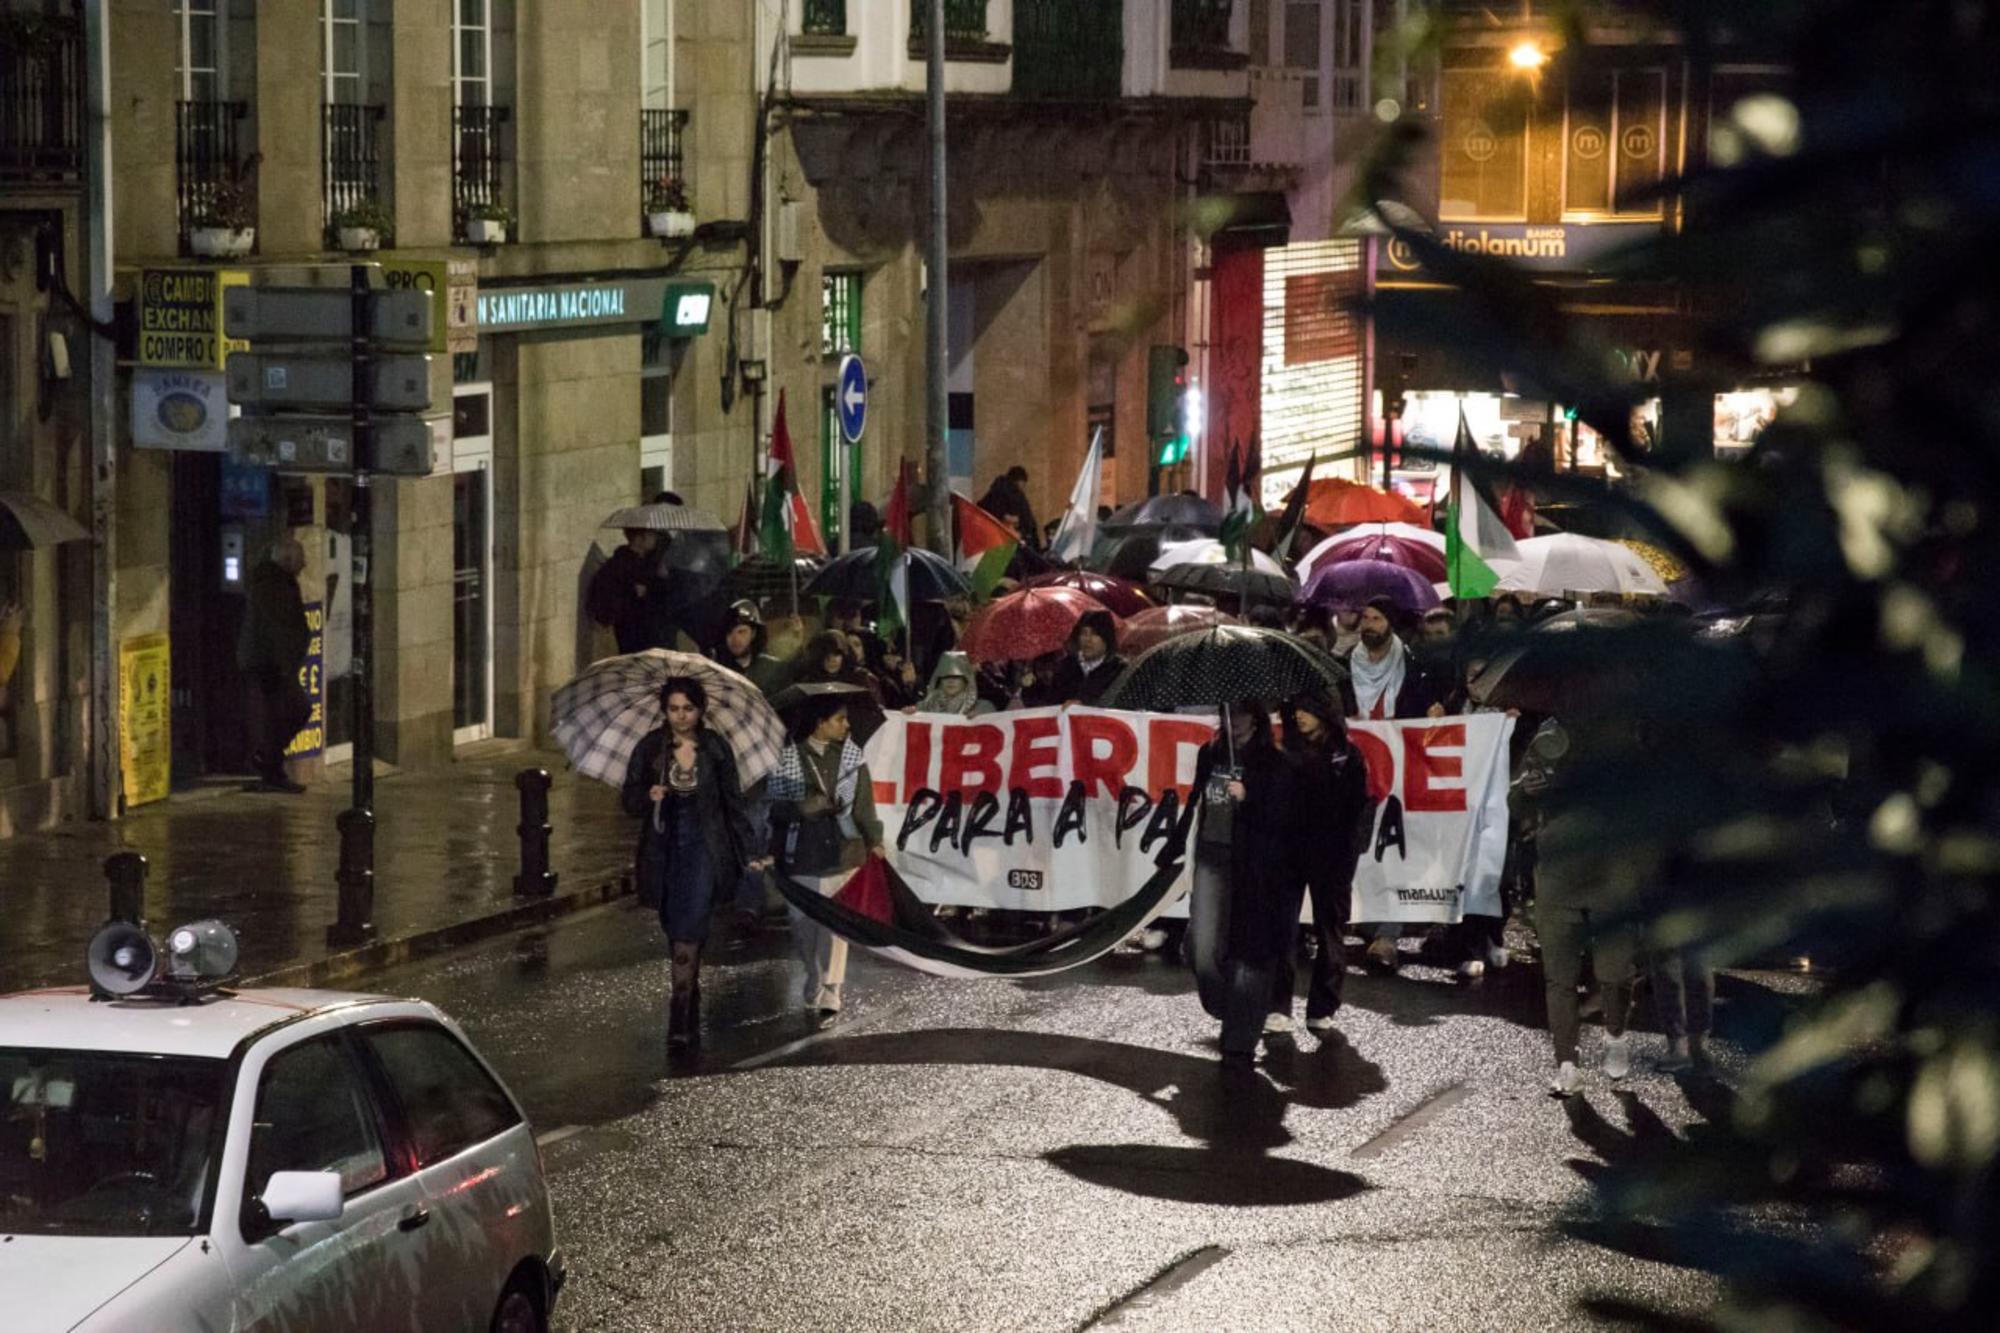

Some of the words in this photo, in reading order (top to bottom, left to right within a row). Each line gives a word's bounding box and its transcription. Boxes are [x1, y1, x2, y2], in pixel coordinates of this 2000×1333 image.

[1526, 229, 1565, 239] BANCO
[490, 291, 556, 325] SANITARIA
[560, 288, 625, 320] NACIONAL
[145, 336, 204, 362] COMPRO
[897, 787, 1033, 858] PARA
[1053, 780, 1087, 849] A
[1011, 871, 1039, 889] BDS
